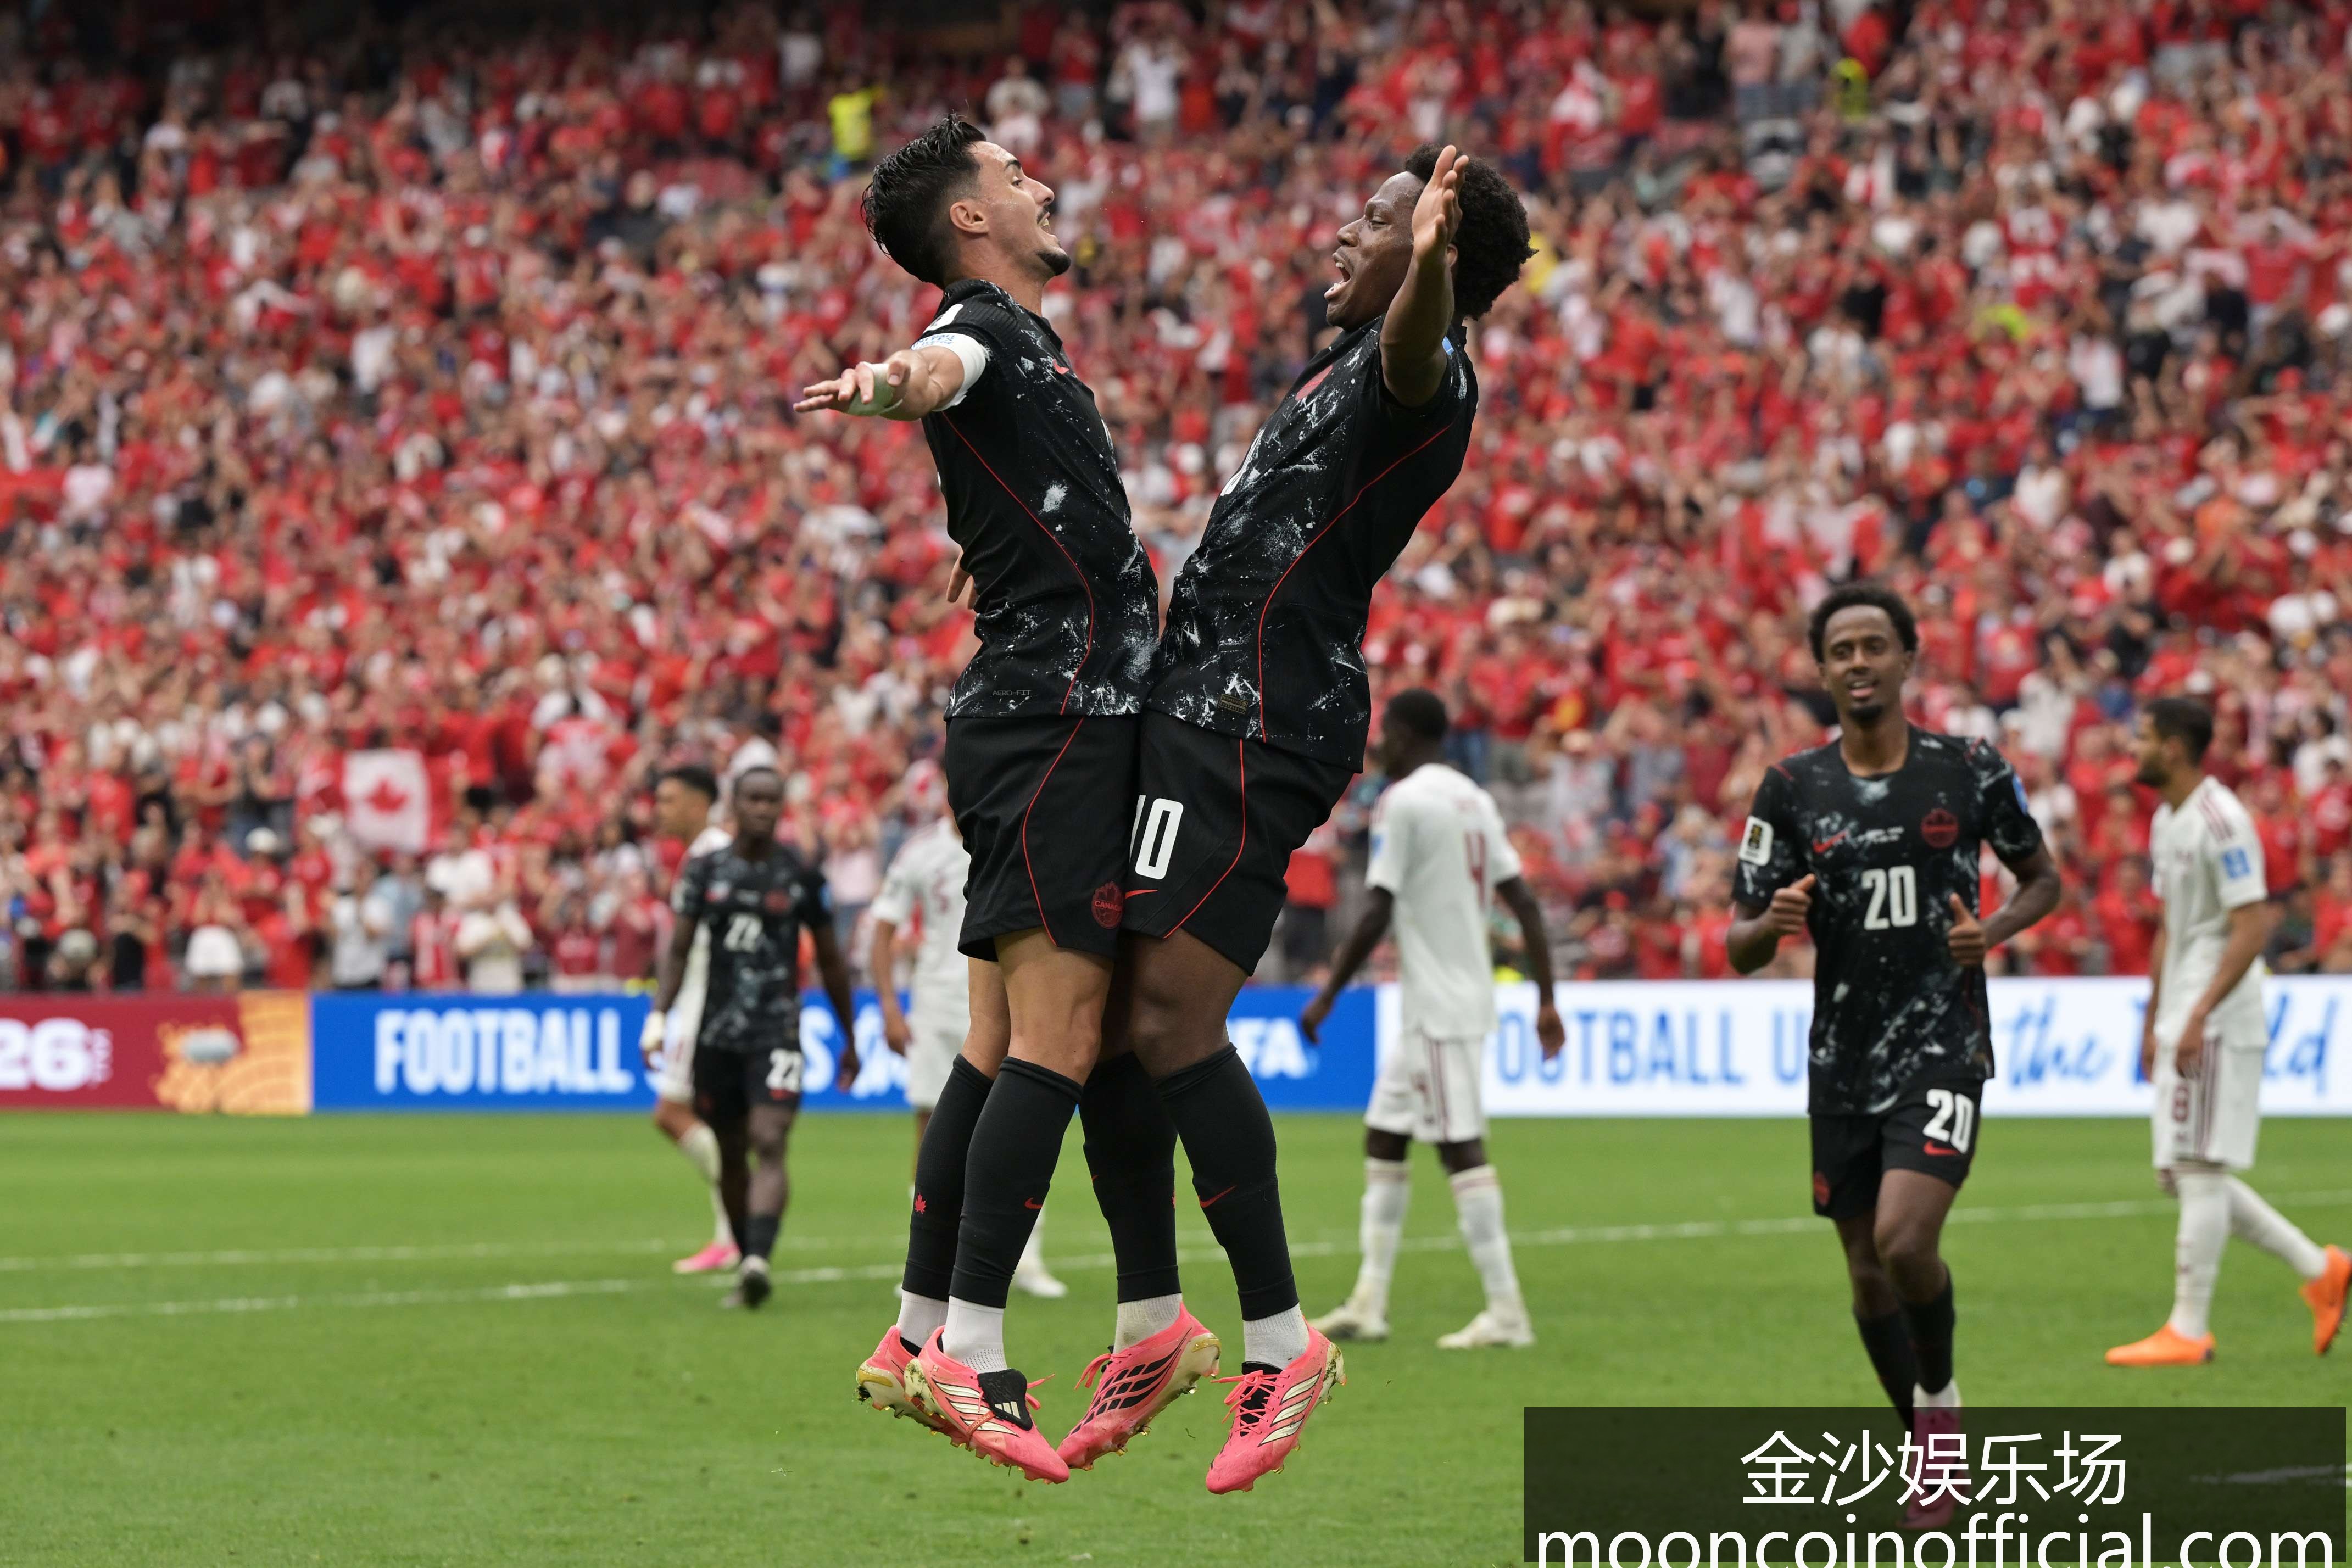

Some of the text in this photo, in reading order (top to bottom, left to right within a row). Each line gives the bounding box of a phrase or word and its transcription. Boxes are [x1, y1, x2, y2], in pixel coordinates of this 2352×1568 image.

[1463, 828, 1489, 909] 4
[1862, 866, 1917, 930] 20
[375, 1008, 634, 1094] FOOTBALL
[1496, 1009, 1747, 1086] OTBALL
[1922, 1088, 1974, 1154] 20
